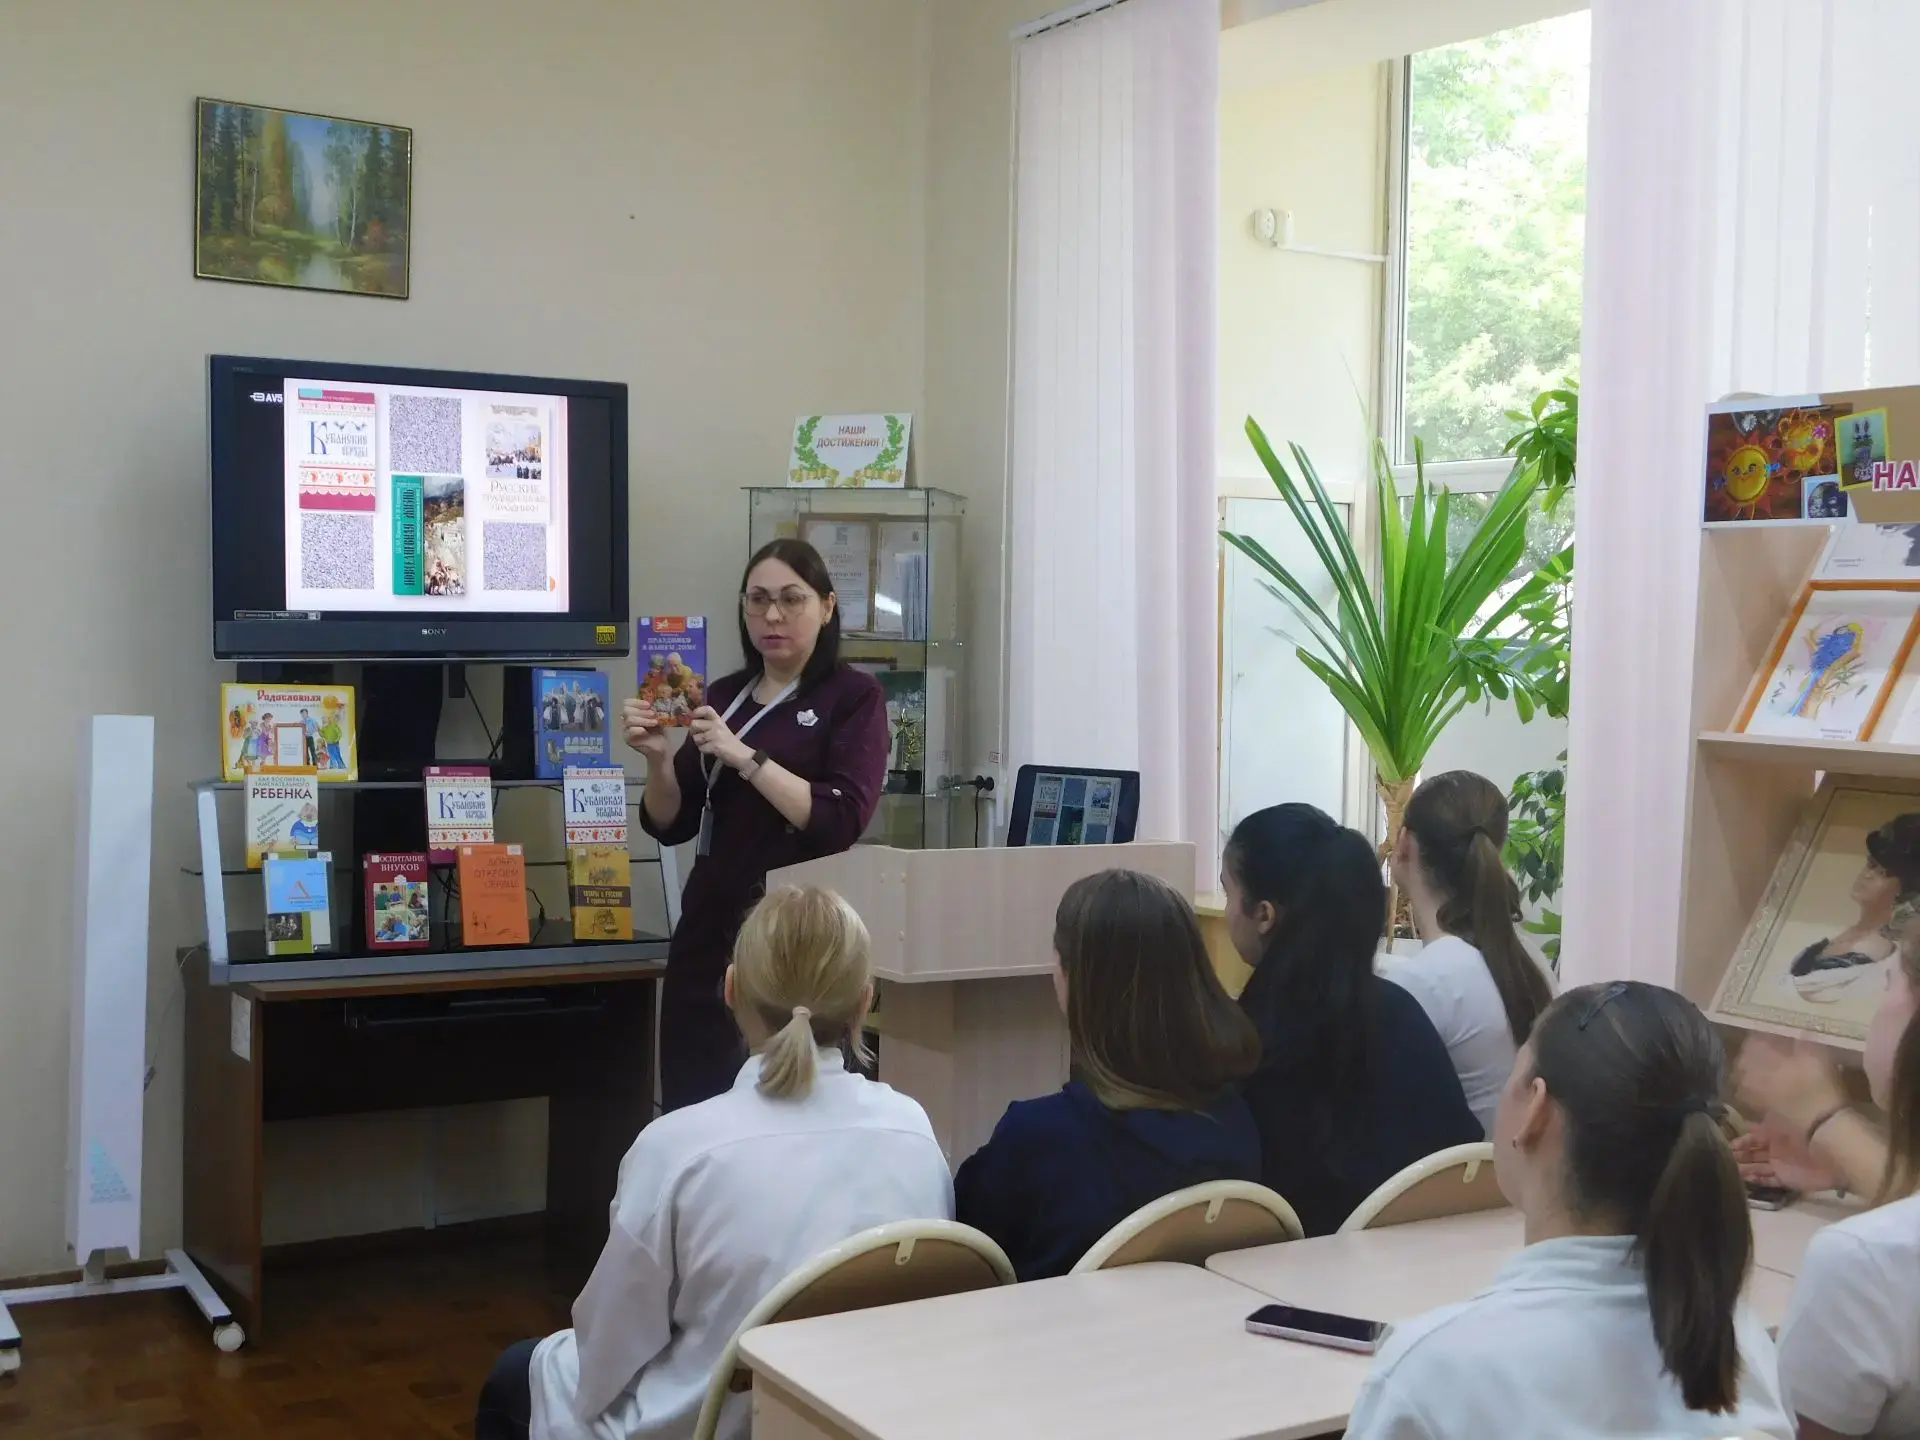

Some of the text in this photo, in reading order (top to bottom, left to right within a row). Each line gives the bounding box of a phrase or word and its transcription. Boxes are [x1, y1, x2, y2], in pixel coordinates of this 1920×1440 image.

[838, 425, 866, 435] НАШИ
[816, 438, 881, 449] ДОСТИЖЕНИЯ
[1873, 462, 1920, 490] НА
[421, 628, 448, 636] SONY
[252, 788, 313, 799] РЕБЕНКА
[381, 863, 420, 871] ВНУКОВ
